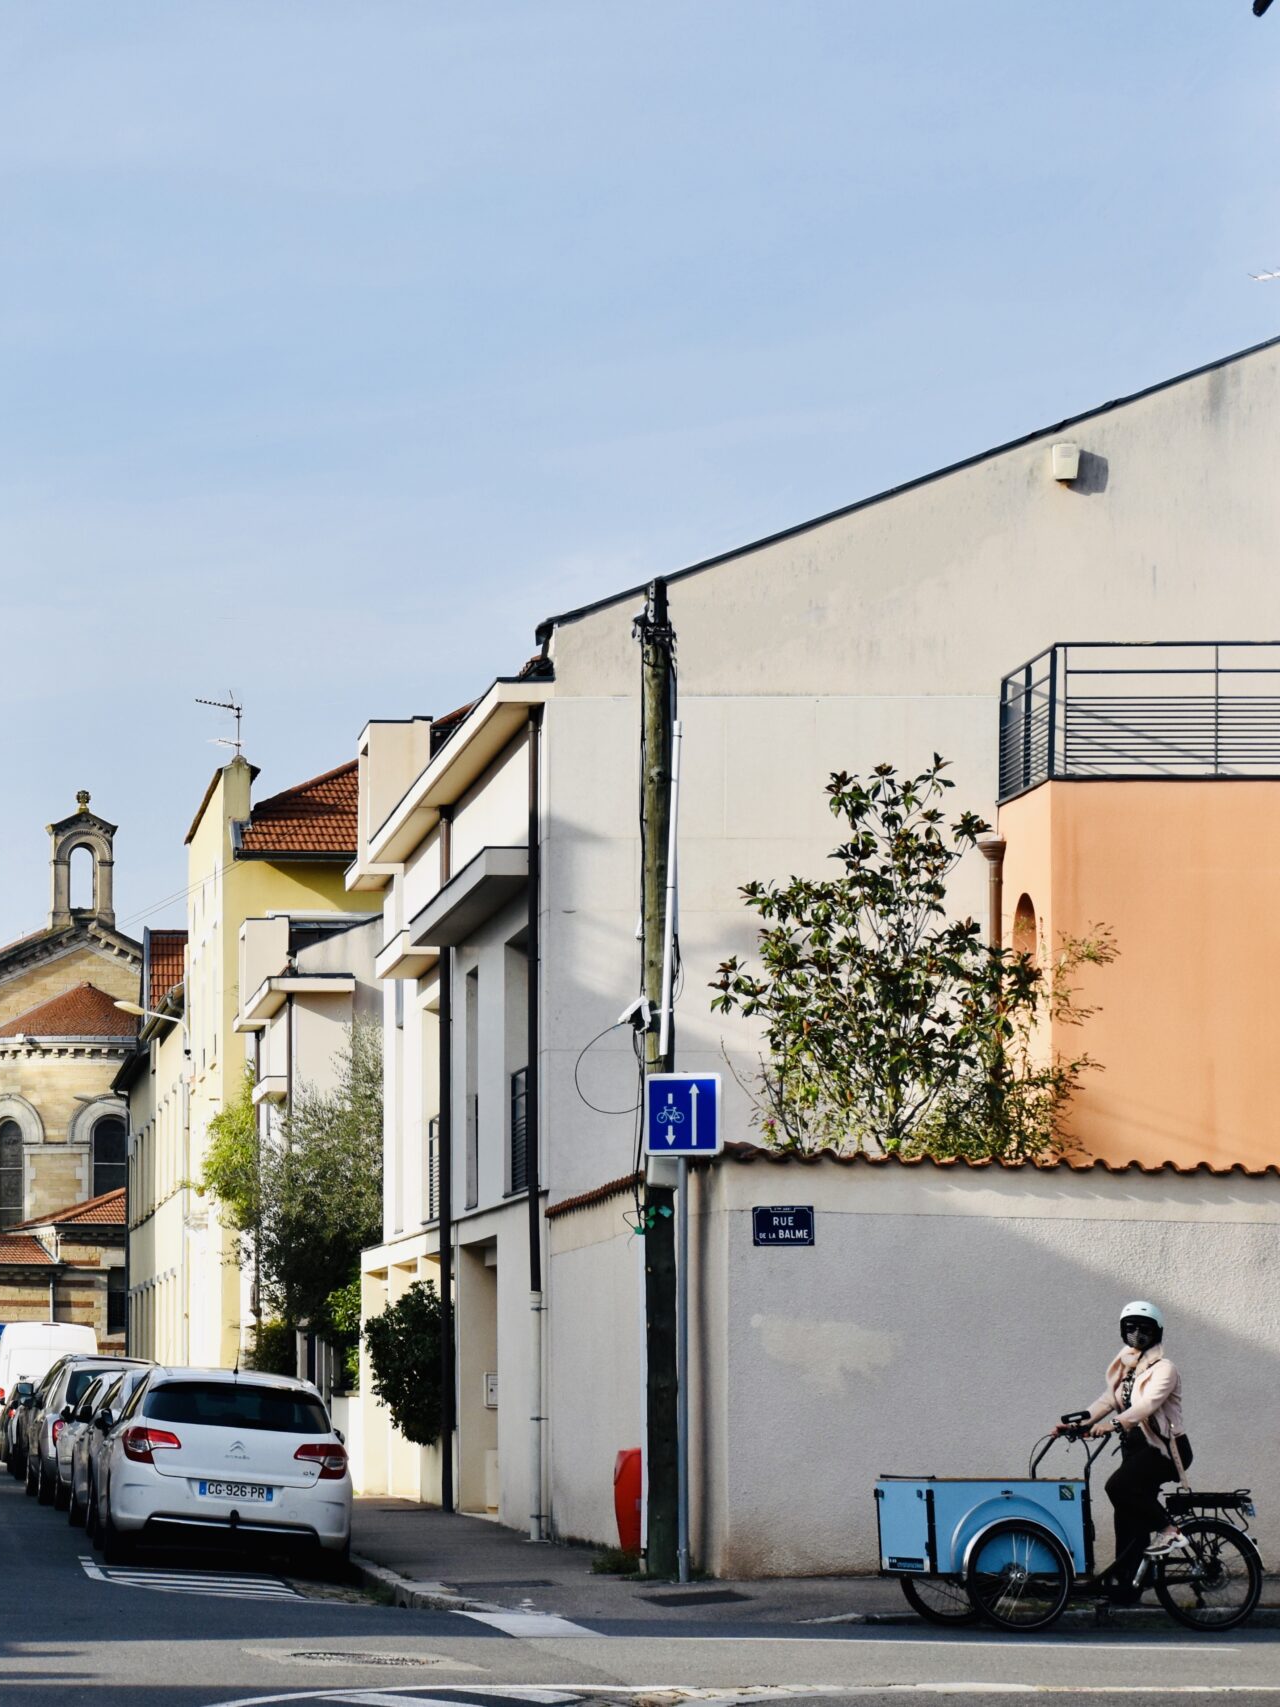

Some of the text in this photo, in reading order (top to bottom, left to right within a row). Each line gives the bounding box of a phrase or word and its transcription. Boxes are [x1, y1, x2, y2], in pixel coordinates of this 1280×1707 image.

[772, 1216, 794, 1226] RUE
[778, 1229, 809, 1239] BALME
[208, 1483, 265, 1499] CG-926-PR
